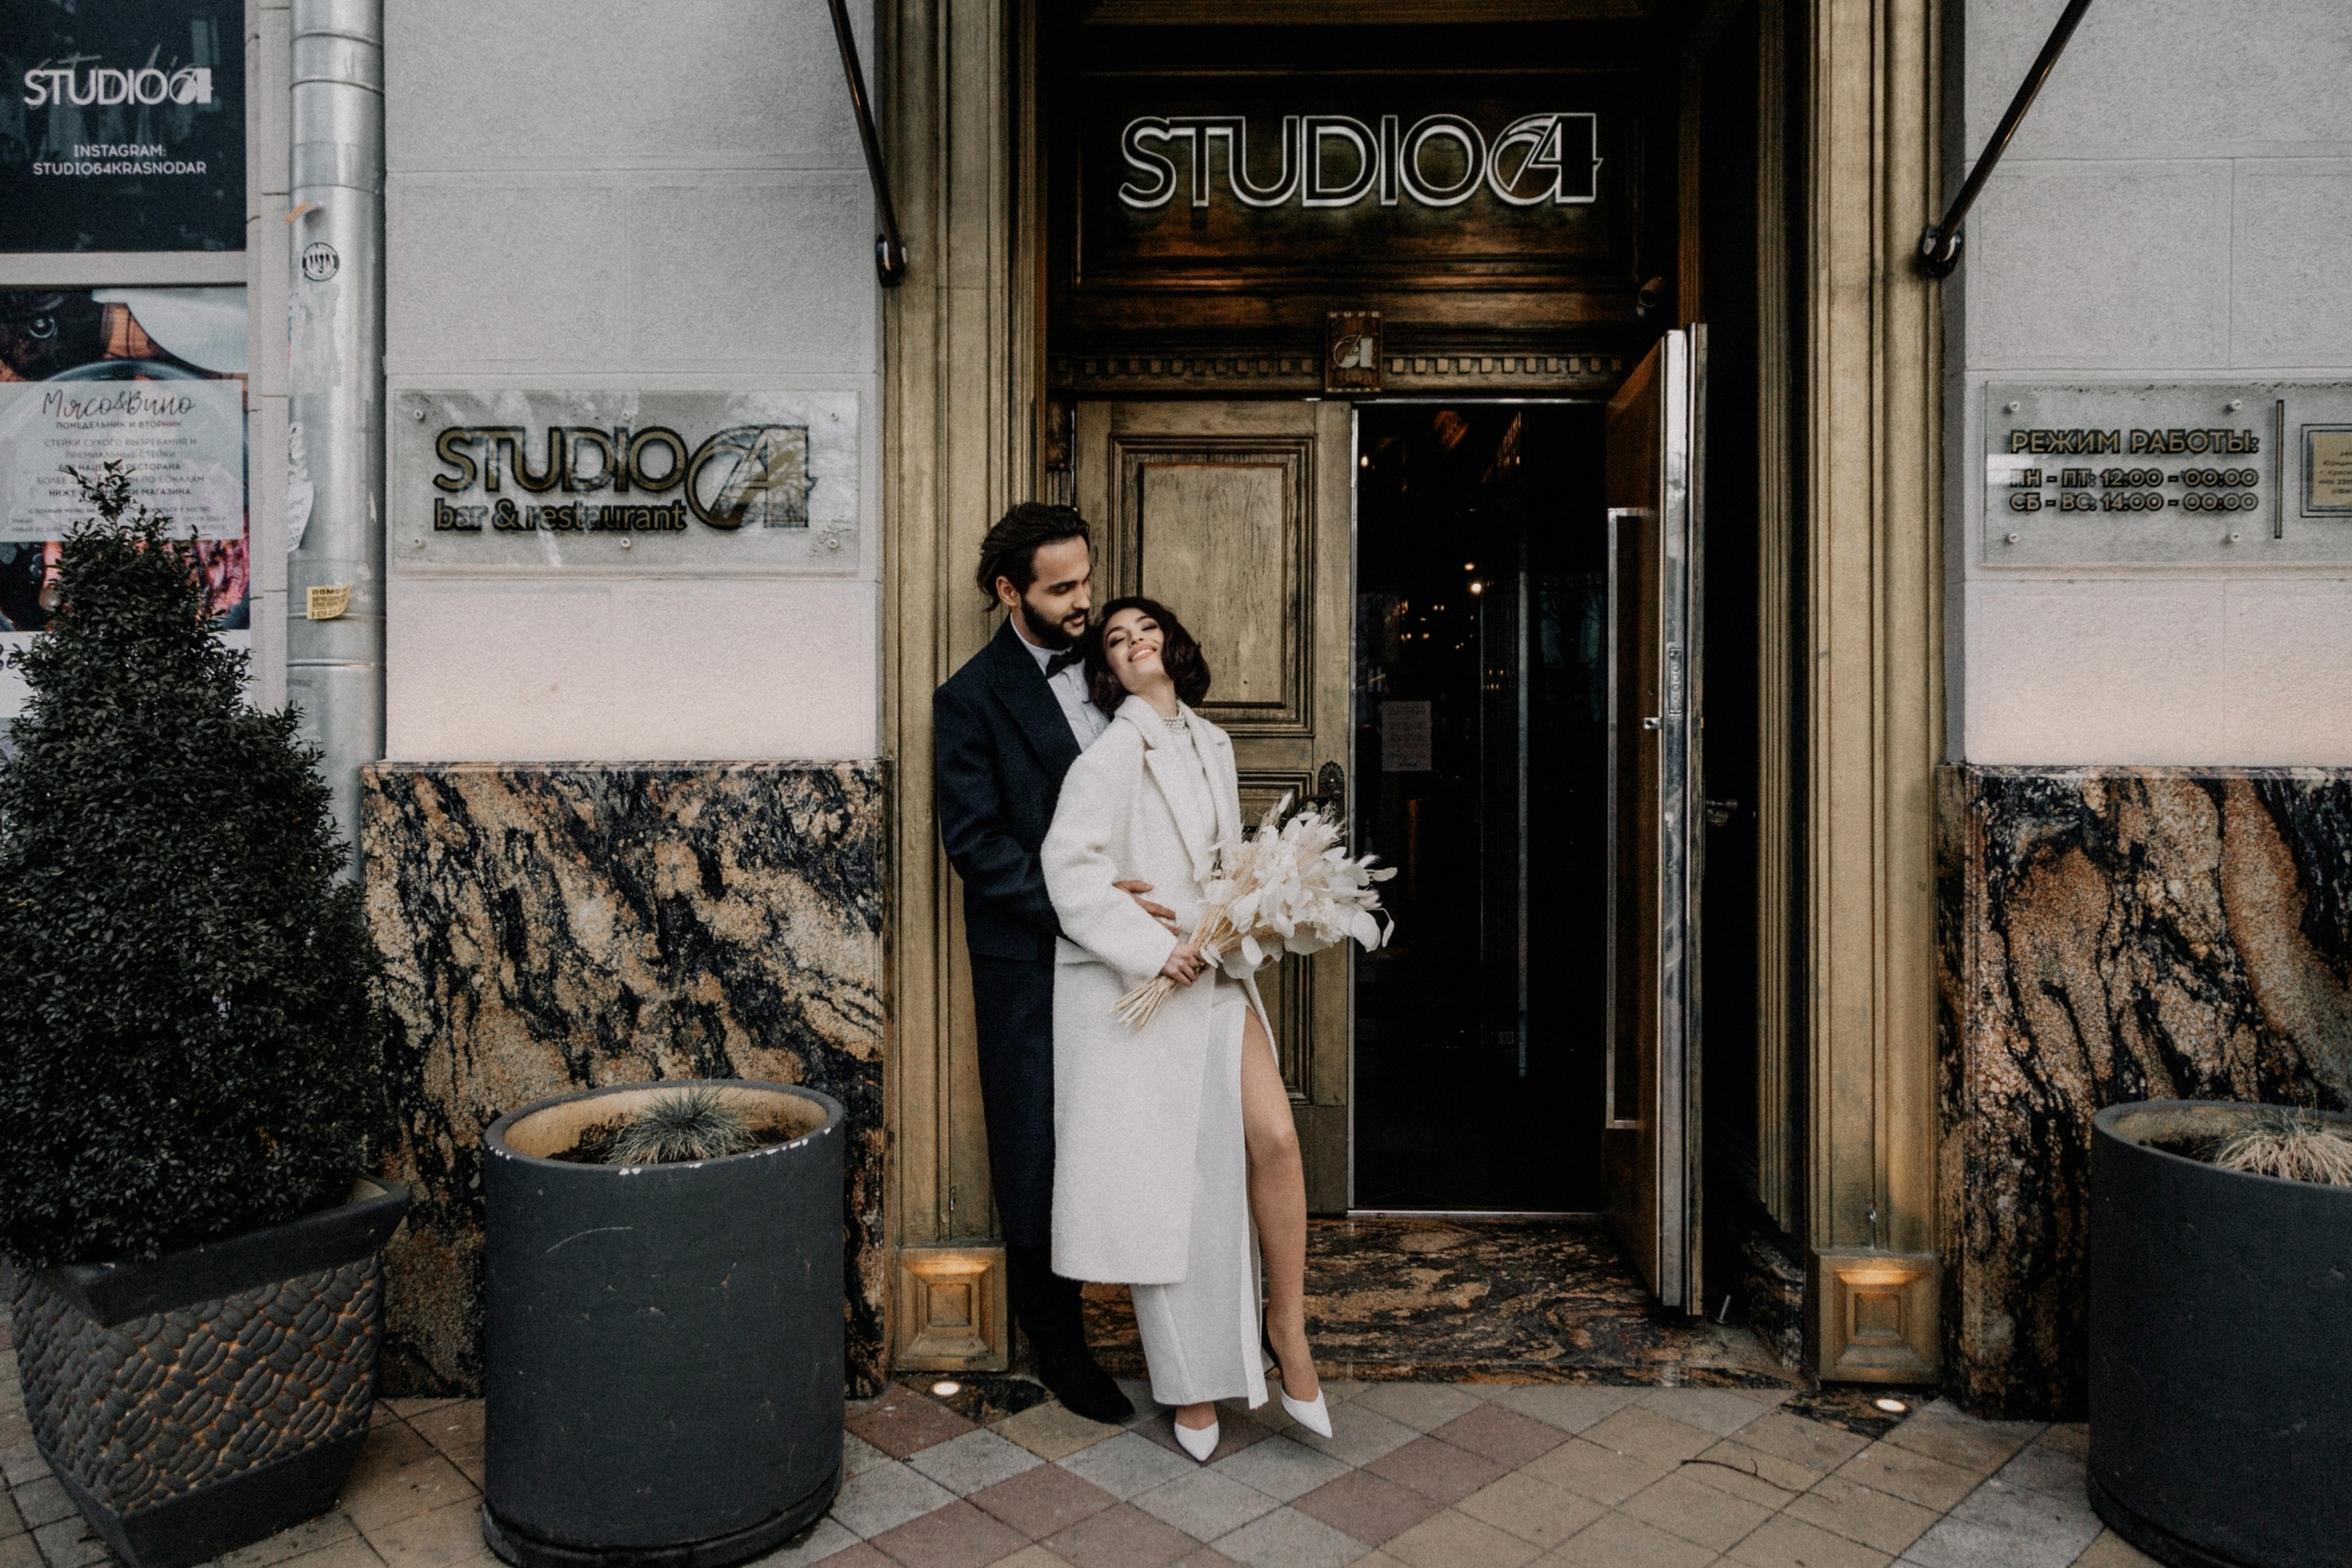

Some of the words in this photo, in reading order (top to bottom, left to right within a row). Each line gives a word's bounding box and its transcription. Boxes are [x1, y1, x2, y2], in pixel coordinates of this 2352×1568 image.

[74, 143, 166, 158] INSTAGRAM:
[33, 161, 207, 175] STUDIO64KRASNODAR
[56, 421, 125, 430] ПОНЕДЕЛЬНИК
[139, 420, 183, 429] ВТОРНИК
[44, 438, 81, 447] СТЕЙКИ
[2010, 429, 2120, 454] РЕЖИМ
[2129, 429, 2259, 454] РАБОТЫ:
[140, 449, 175, 457] СТЕЙКИ
[2010, 468, 2041, 488] ПН
[2062, 468, 2096, 488] ПТ:
[2100, 468, 2164, 488] 12:00
[2183, 468, 2259, 488] 00:00
[2009, 492, 2041, 512] СБ
[2061, 492, 2097, 512] ВС:
[2183, 492, 2259, 512] 00:00
[434, 497, 488, 532] bar
[526, 500, 687, 532] restaurant
